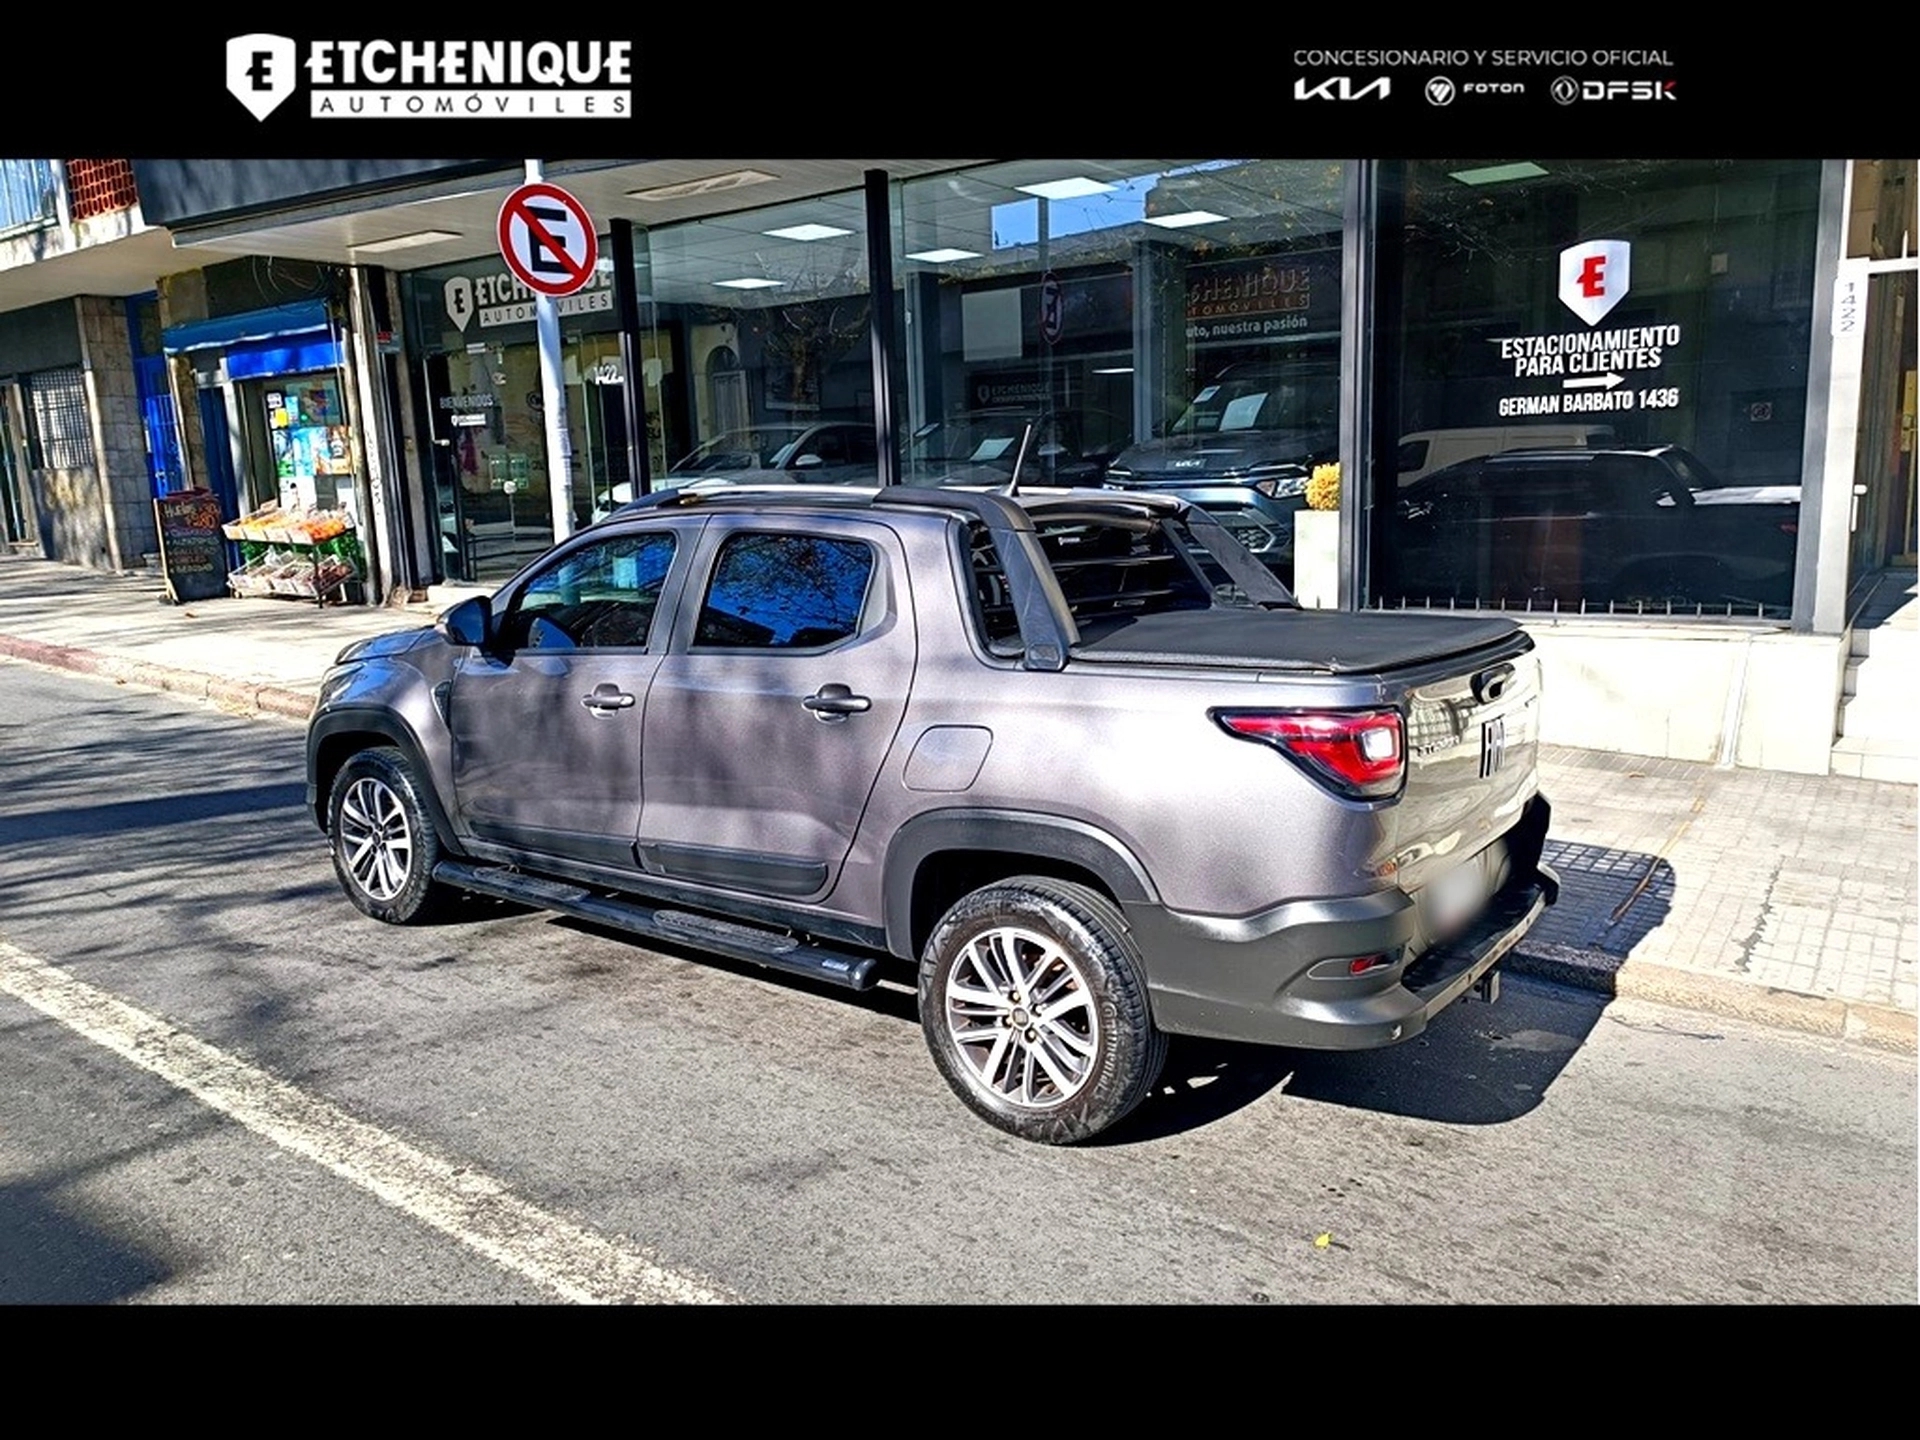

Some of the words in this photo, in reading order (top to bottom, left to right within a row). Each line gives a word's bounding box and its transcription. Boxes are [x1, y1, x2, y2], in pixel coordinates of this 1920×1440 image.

[482, 293, 609, 324] AUTOMVILES
[1212, 320, 1261, 335] nuestra
[1263, 313, 1309, 334] pasión
[1501, 324, 1681, 359] ESTACIONAMIENTO
[1514, 354, 1565, 378] PARA
[1568, 347, 1663, 374] CLIENTES
[1498, 394, 1560, 417] GERMAN
[1563, 390, 1634, 413] BARBATO
[1638, 387, 1680, 410] 1436
